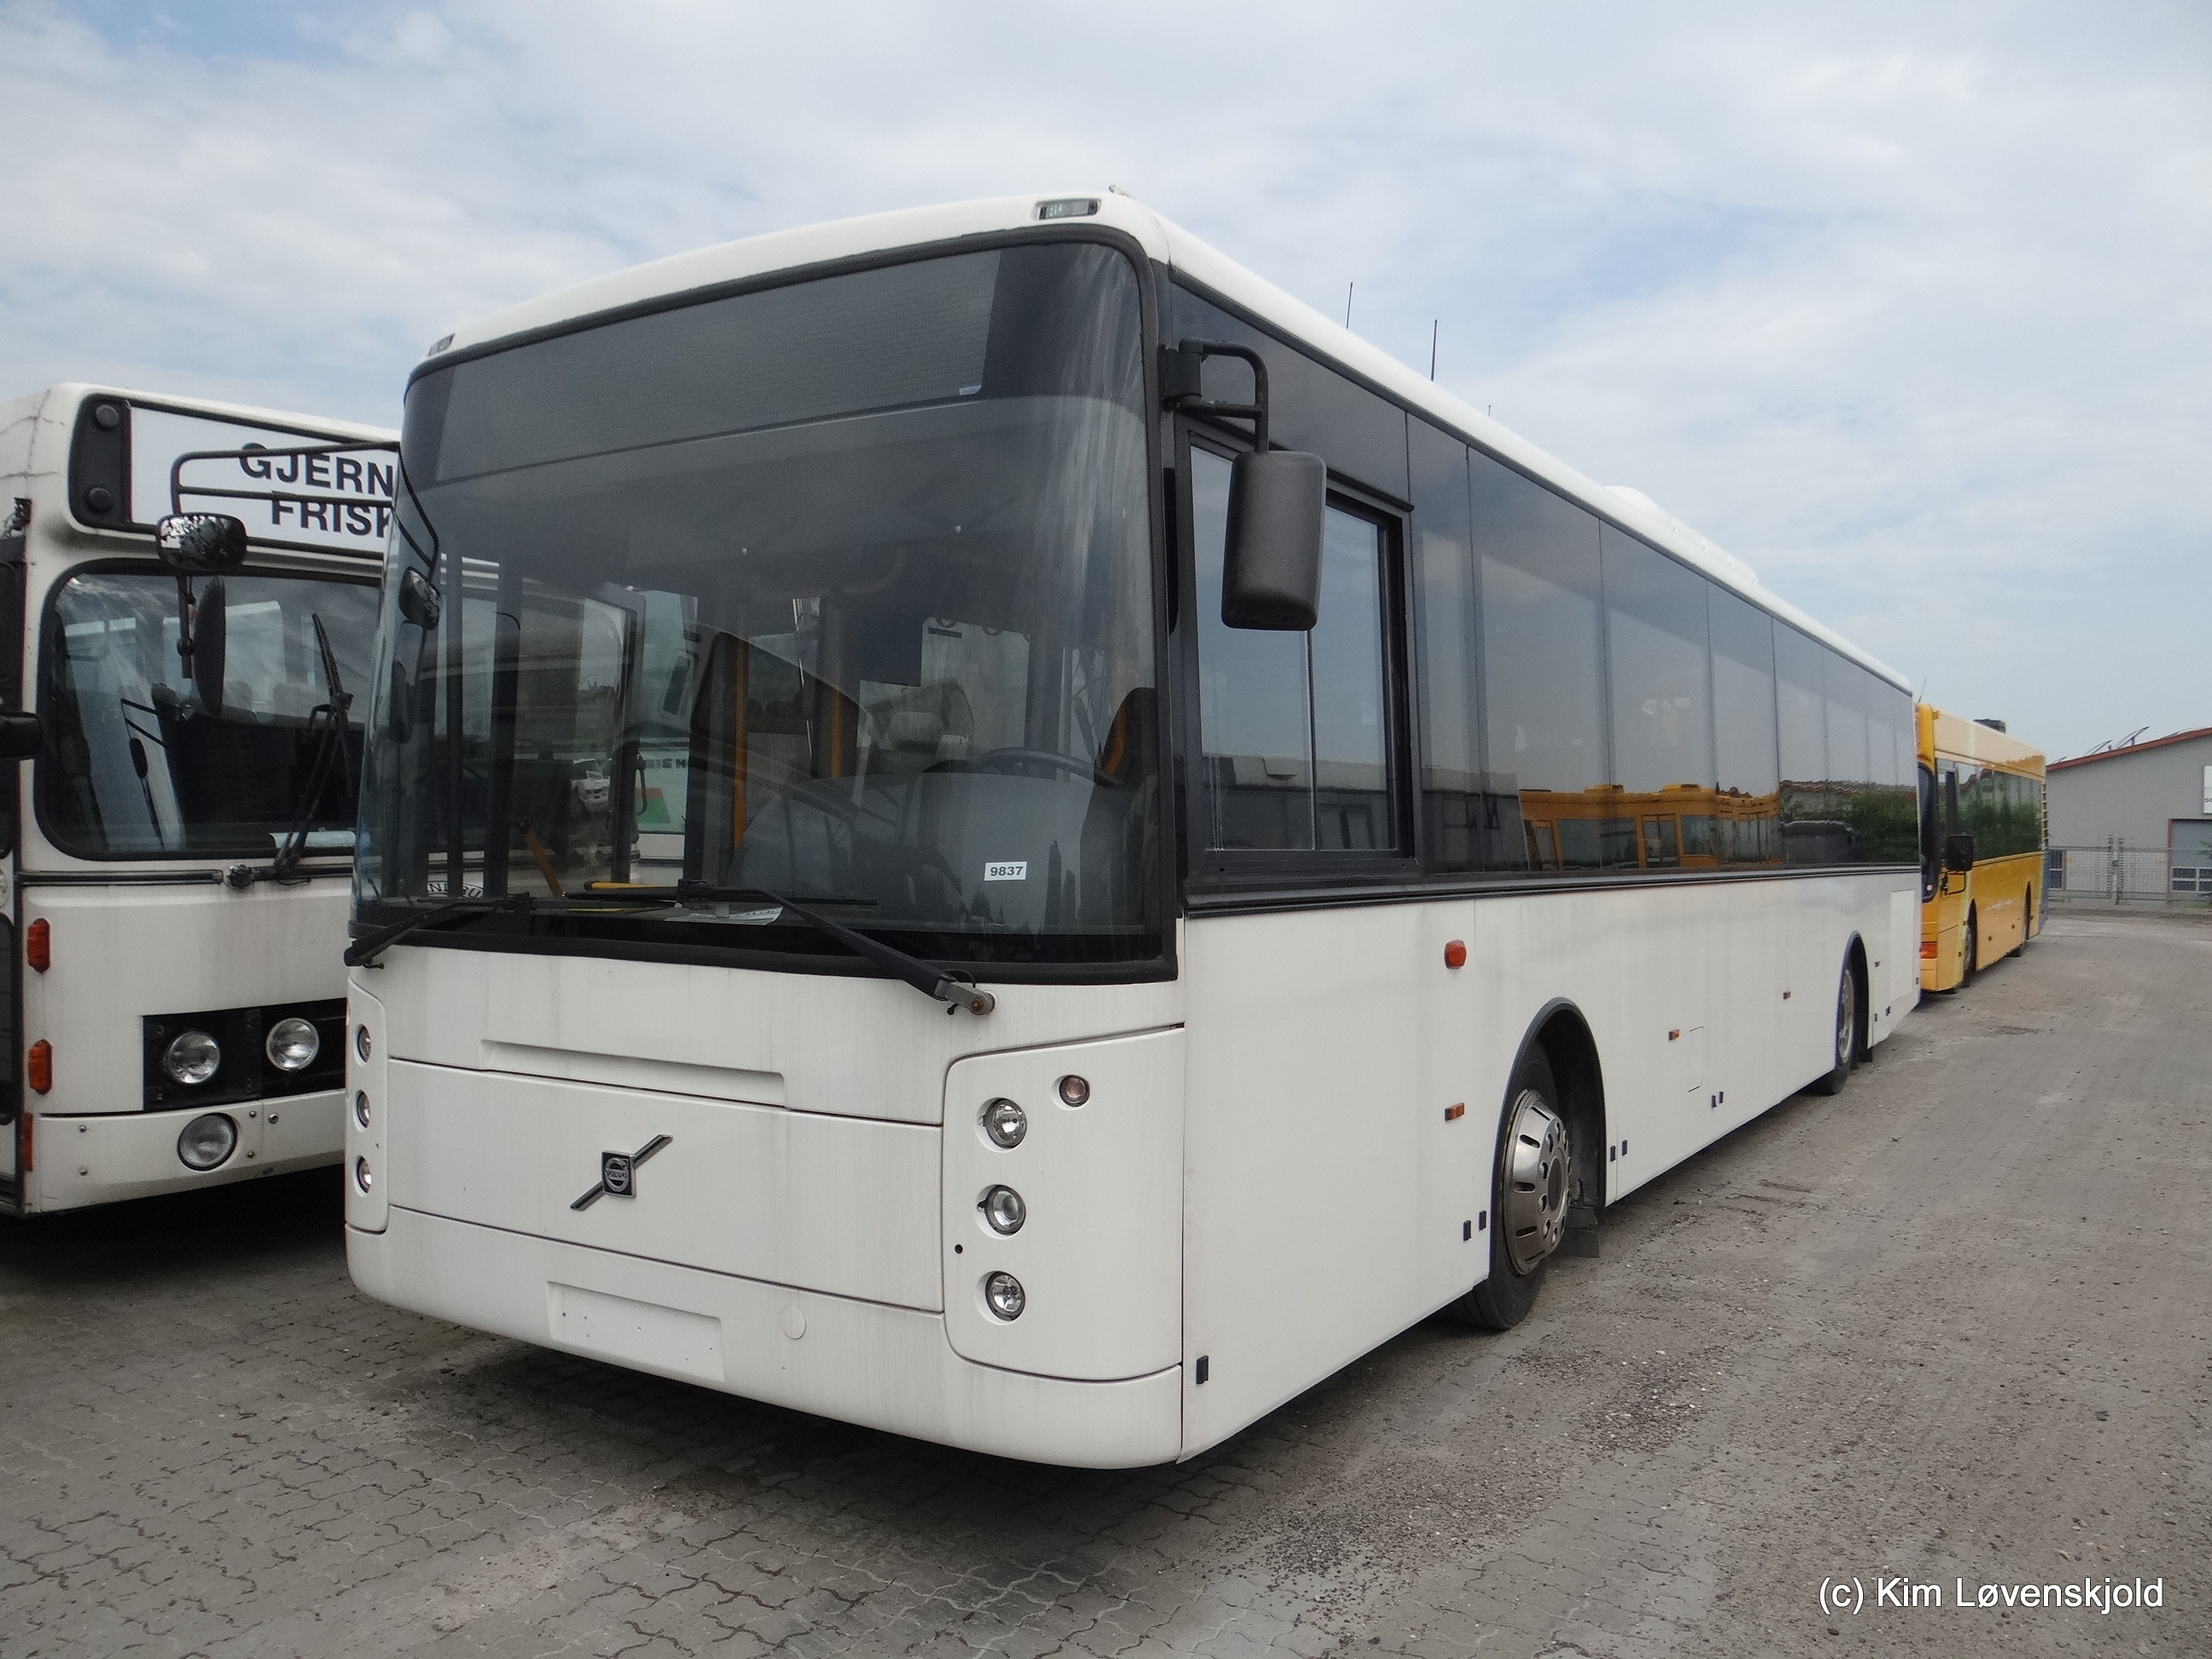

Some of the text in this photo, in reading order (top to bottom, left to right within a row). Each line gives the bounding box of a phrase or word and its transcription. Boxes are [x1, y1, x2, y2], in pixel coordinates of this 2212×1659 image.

[239, 443, 393, 497] GJERN
[990, 866, 1023, 876] 9837
[605, 1169, 628, 1179] VOLVO
